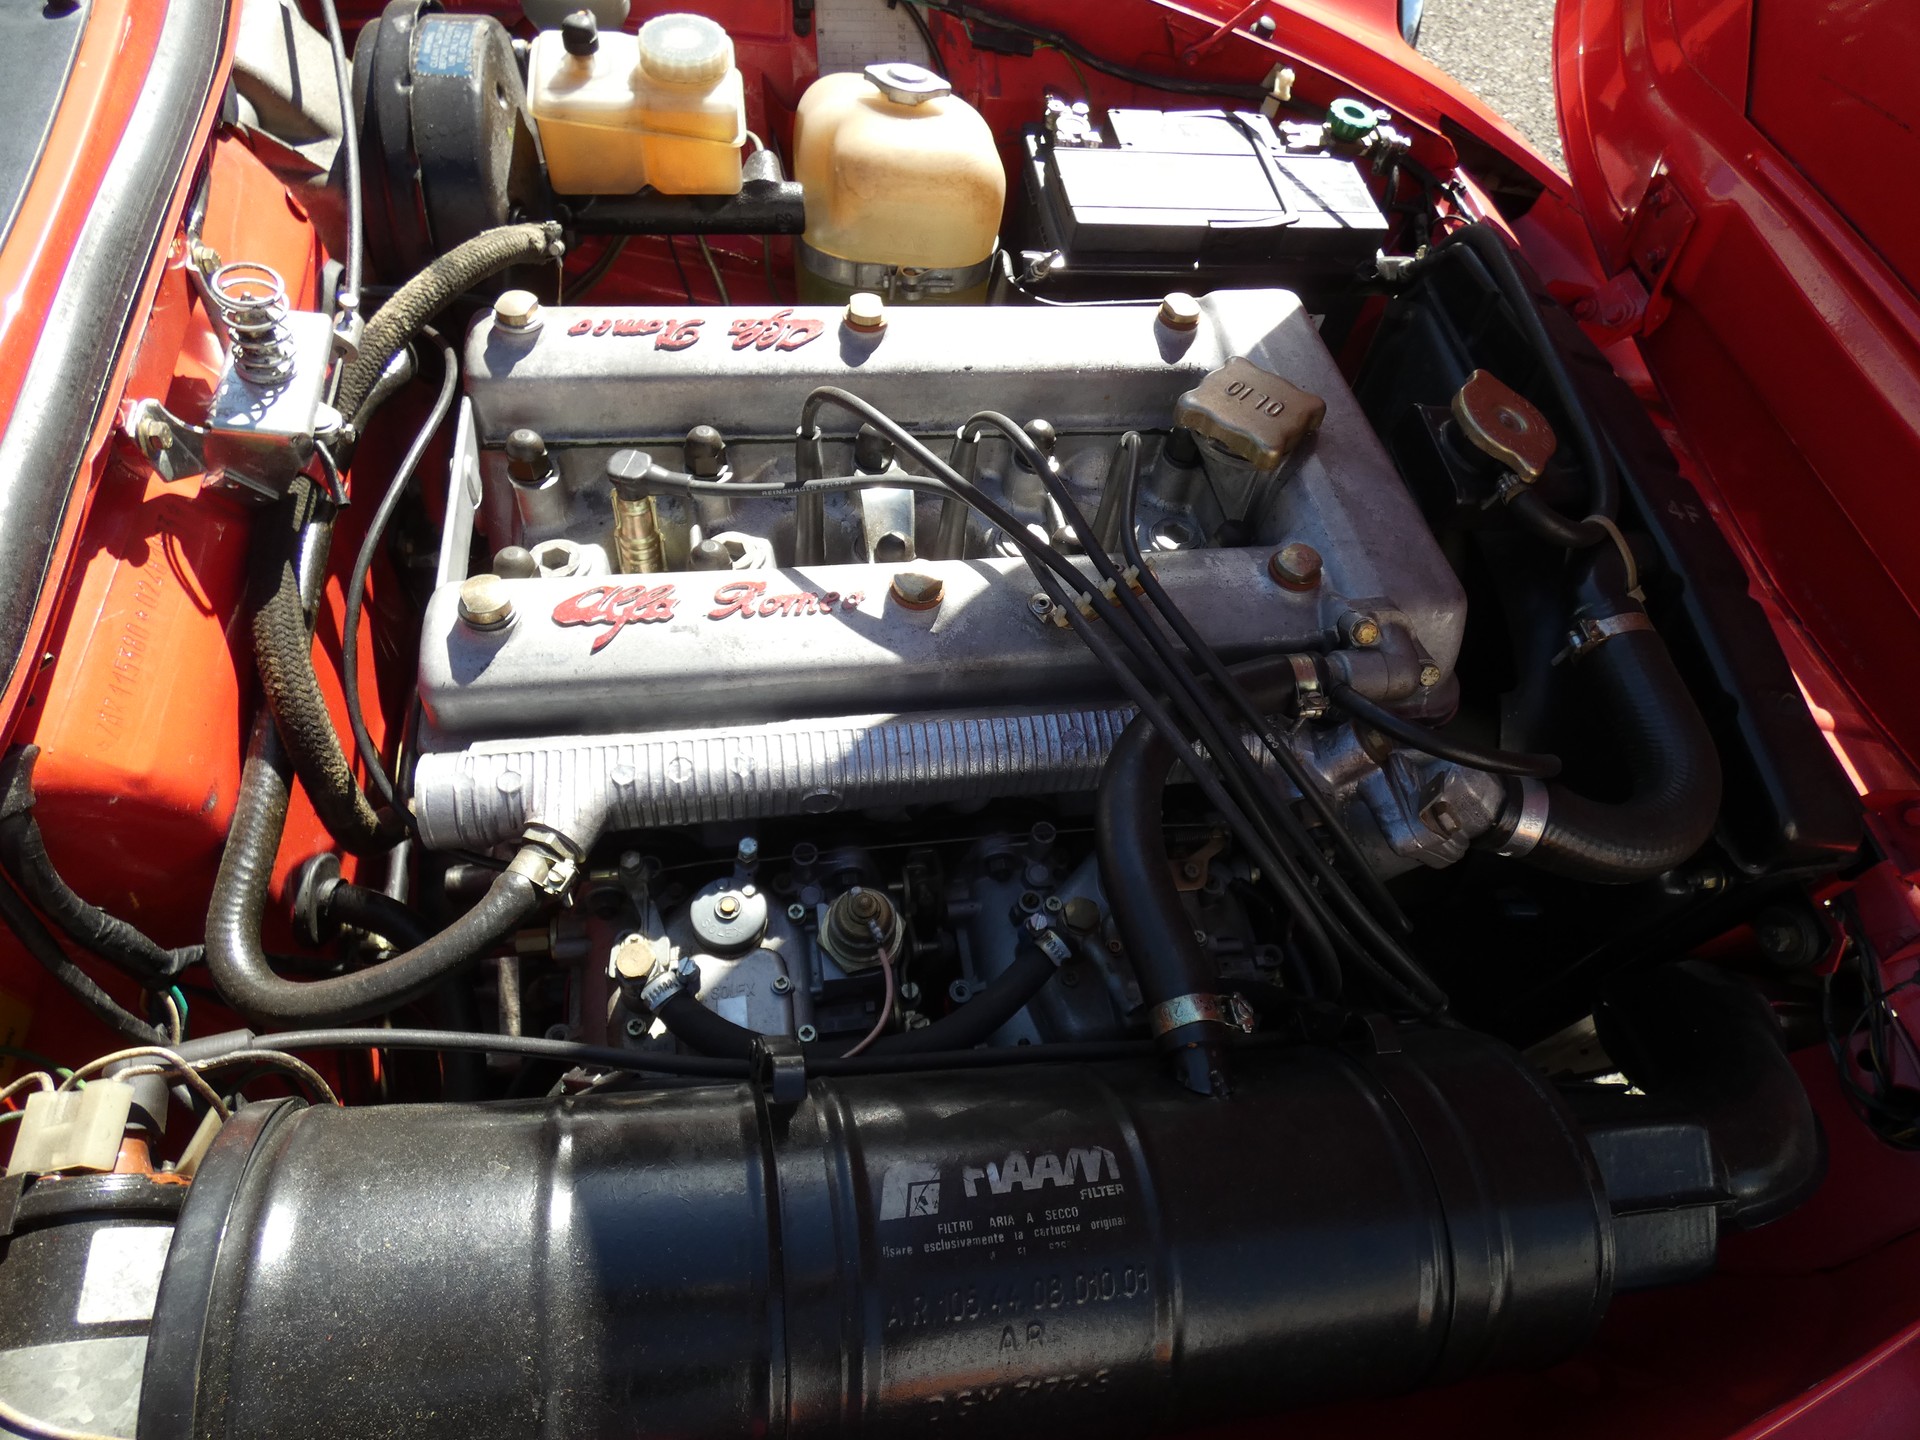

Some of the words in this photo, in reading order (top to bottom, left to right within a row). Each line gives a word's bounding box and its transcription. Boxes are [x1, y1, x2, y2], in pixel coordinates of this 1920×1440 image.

[567, 319, 705, 351] Romeo
[727, 309, 825, 351] Alfa
[552, 584, 680, 655] Alfa
[706, 581, 865, 621] Romeo
[701, 918, 744, 938] SOLEX
[711, 983, 756, 1000] SOLEX
[1080, 1184, 1125, 1200] FILTER
[937, 1219, 974, 1235] FILTRO
[989, 1214, 1015, 1228] ARIA
[1026, 1212, 1034, 1224] A
[1045, 1206, 1079, 1221] SECCO
[923, 1232, 1005, 1254] esclusivamente
[1034, 1221, 1081, 1238] cartuccia
